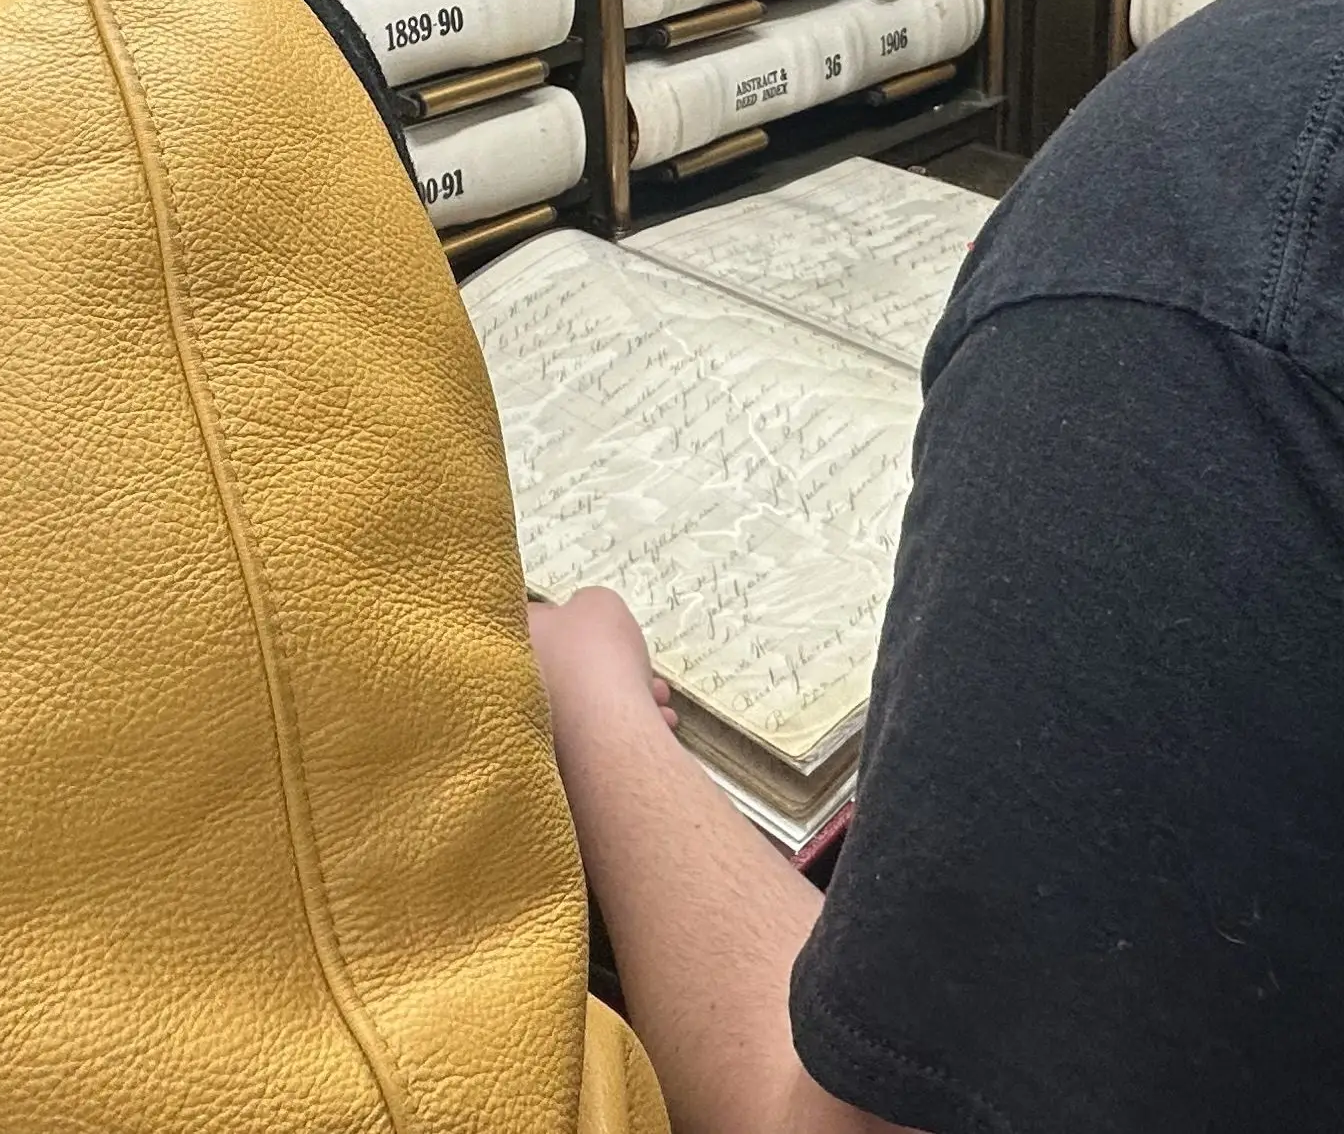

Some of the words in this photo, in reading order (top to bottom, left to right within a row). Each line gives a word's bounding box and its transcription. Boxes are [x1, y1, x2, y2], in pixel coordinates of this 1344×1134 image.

[385, 6, 464, 51] 1889-90
[880, 27, 908, 56] 1906
[825, 54, 841, 80] 36
[736, 70, 777, 96] ABSTRACT
[780, 68, 787, 81] &
[736, 93, 757, 112] DEED
[762, 82, 788, 101] INDEX
